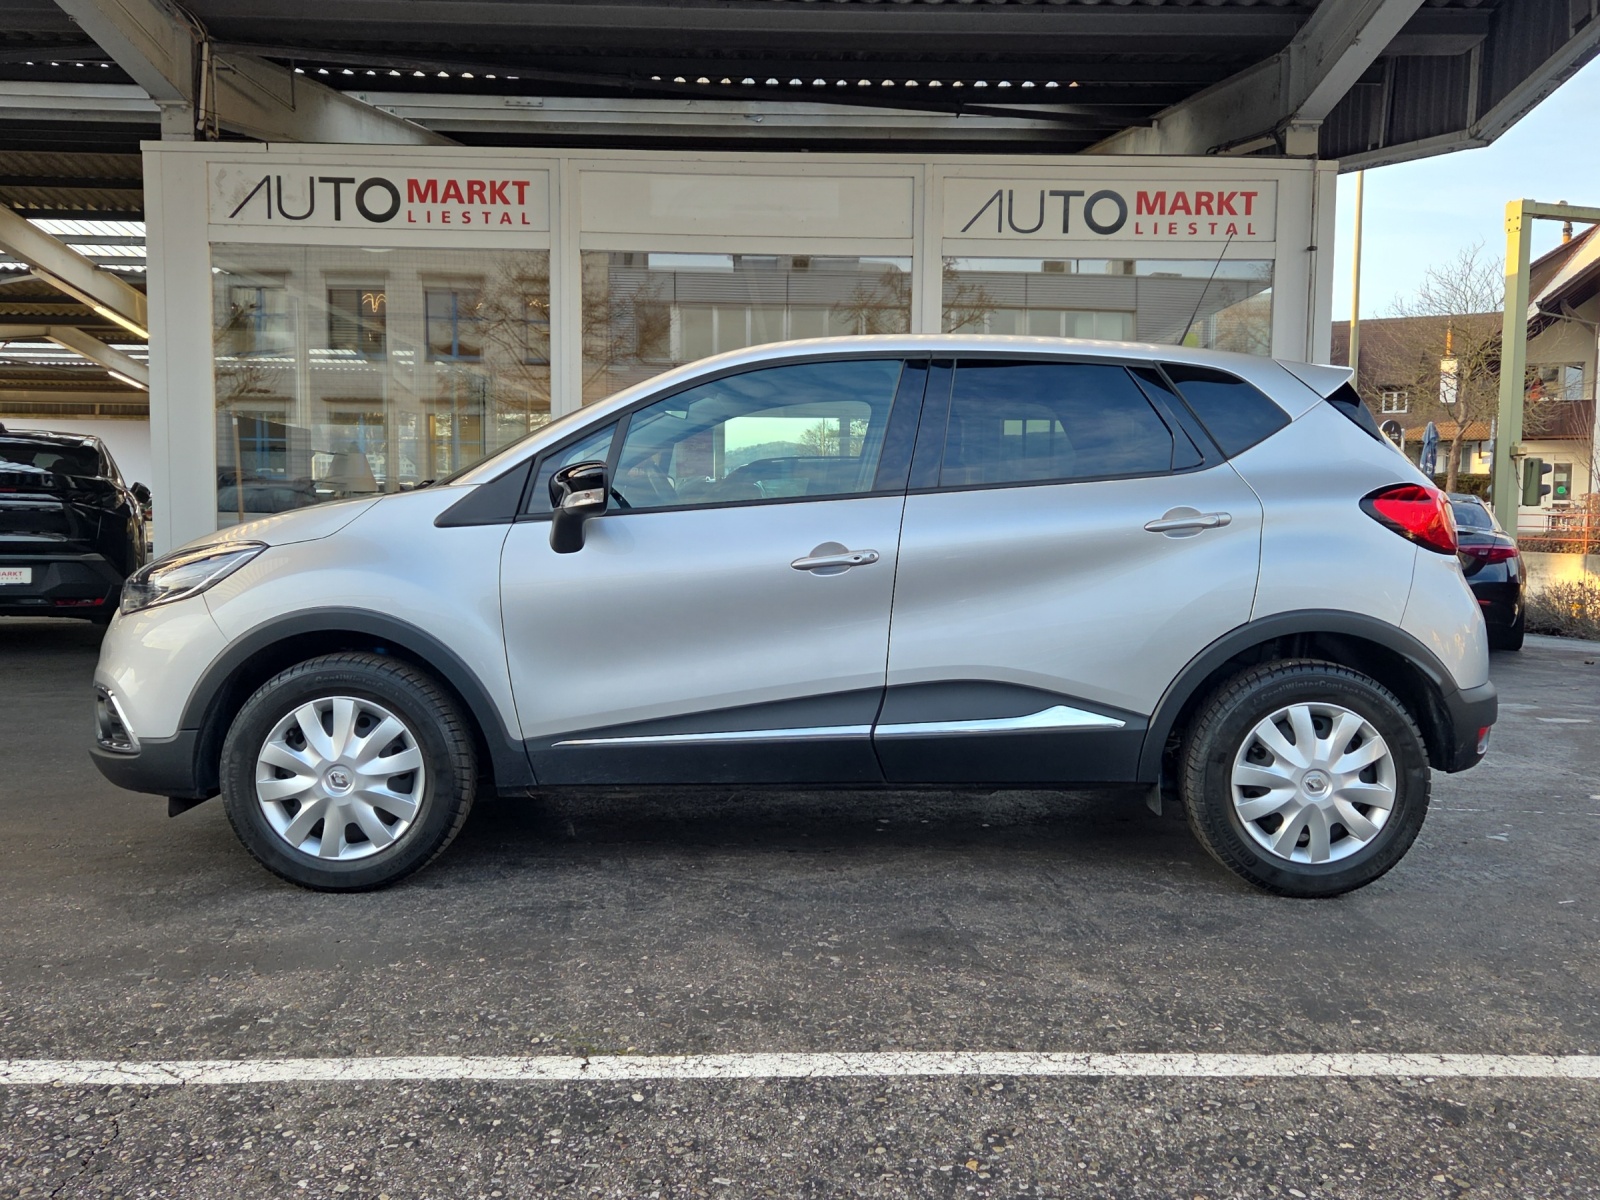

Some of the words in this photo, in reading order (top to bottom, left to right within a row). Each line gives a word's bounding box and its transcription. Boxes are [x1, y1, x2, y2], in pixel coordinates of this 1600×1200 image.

[228, 175, 401, 224] AUTO
[406, 178, 531, 206] MARKT
[960, 189, 1128, 236] AUTO
[1135, 191, 1259, 216] MARKT
[407, 210, 531, 226] LIESTAL
[1135, 222, 1256, 236] LIESTAL
